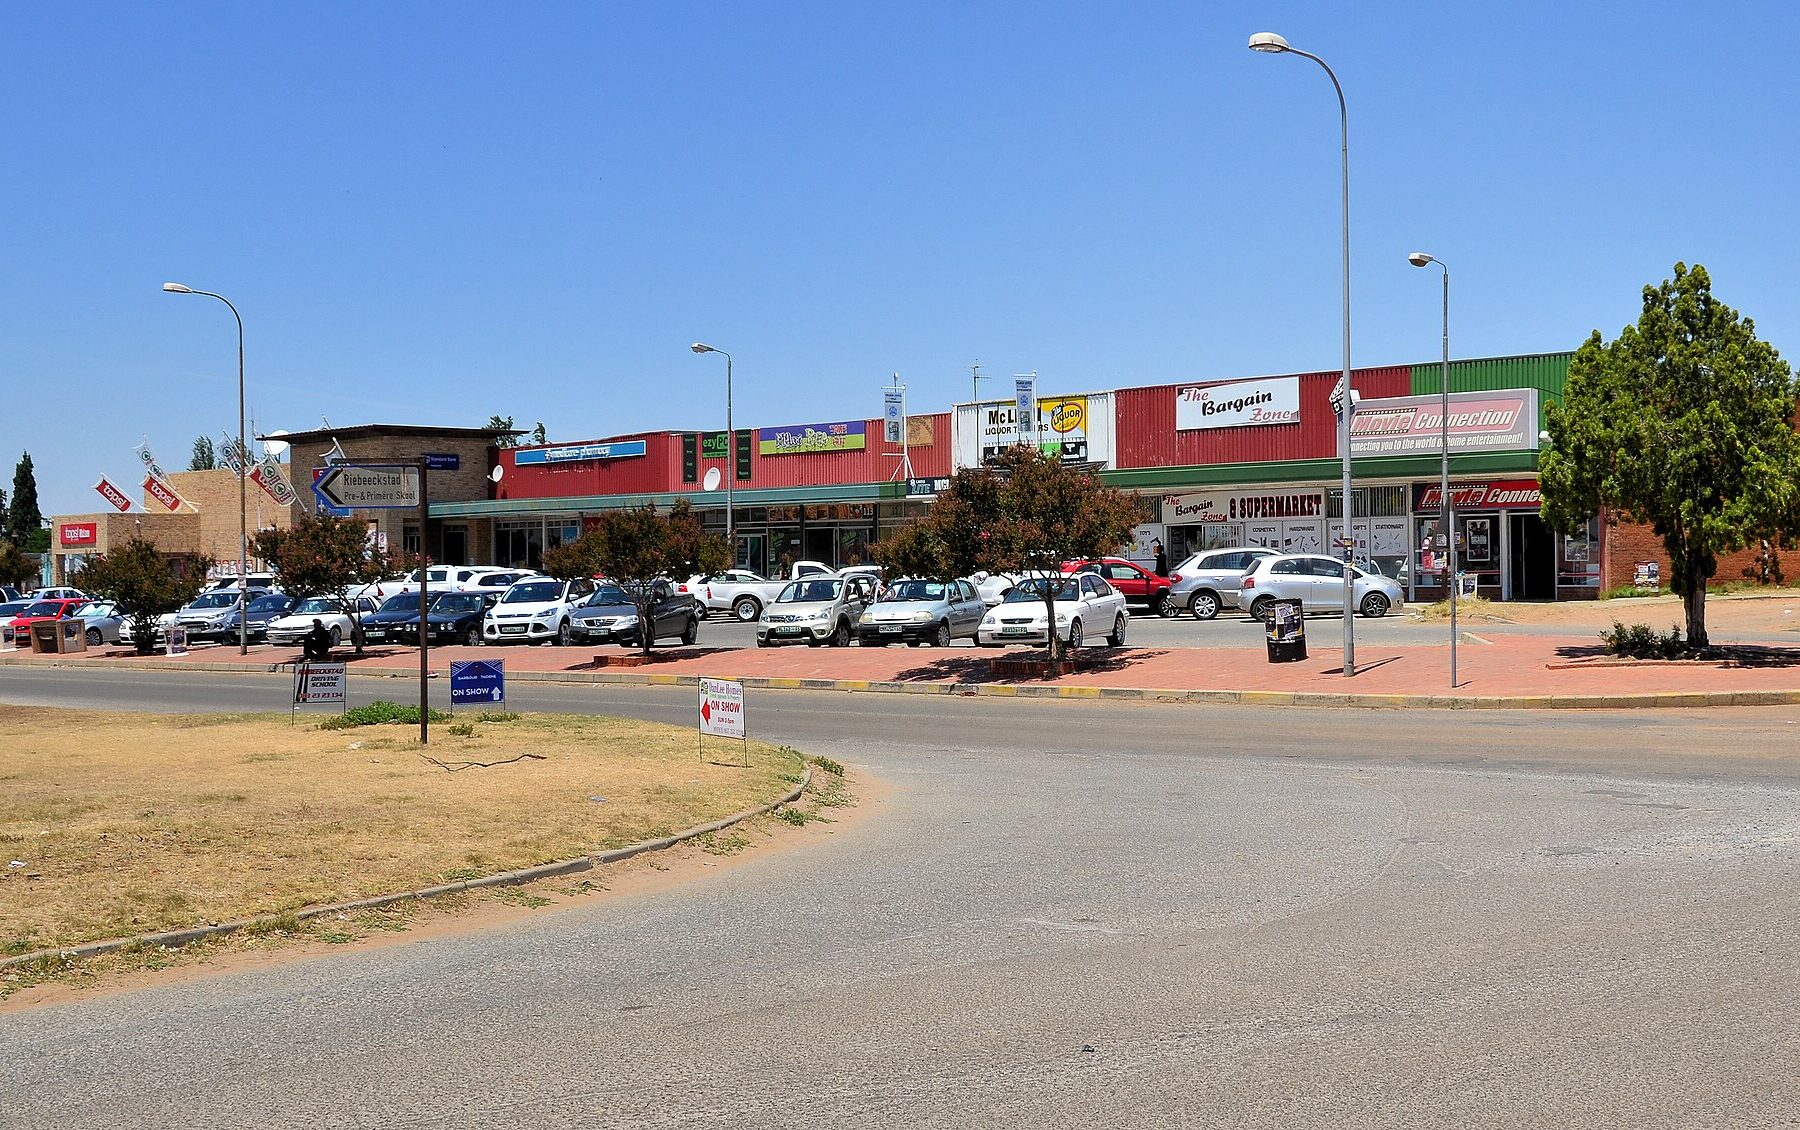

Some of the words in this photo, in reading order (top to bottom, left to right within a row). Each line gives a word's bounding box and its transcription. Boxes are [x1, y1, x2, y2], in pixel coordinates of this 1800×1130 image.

[1184, 389, 1209, 401] The
[1202, 391, 1272, 416] Bargain
[1054, 410, 1081, 425] LIQUOR
[1250, 407, 1291, 421] Zone
[1353, 413, 1411, 432] Movie
[985, 426, 1012, 435] LIQUOR
[1350, 441, 1380, 451] nnecting
[1380, 441, 1394, 451] you
[1394, 439, 1402, 449] to
[1402, 438, 1415, 449] the
[1415, 437, 1436, 448] world
[1446, 436, 1467, 446] home
[1467, 432, 1524, 446] entertainment!
[344, 474, 401, 486] Riebeeckstad
[151, 482, 176, 506] tops!
[396, 490, 416, 500] Skool
[911, 484, 931, 494] LITE
[1424, 489, 1482, 503] Mvie
[1487, 488, 1541, 503] Conne
[103, 485, 127, 508] tops!
[1165, 496, 1180, 505] The
[1175, 500, 1213, 517] Bargain
[1239, 494, 1322, 519] SUPERMARKET
[1201, 511, 1223, 521] Zone
[465, 687, 490, 696] SHOW
[710, 700, 720, 711] ON
[720, 701, 741, 714] SHOW
